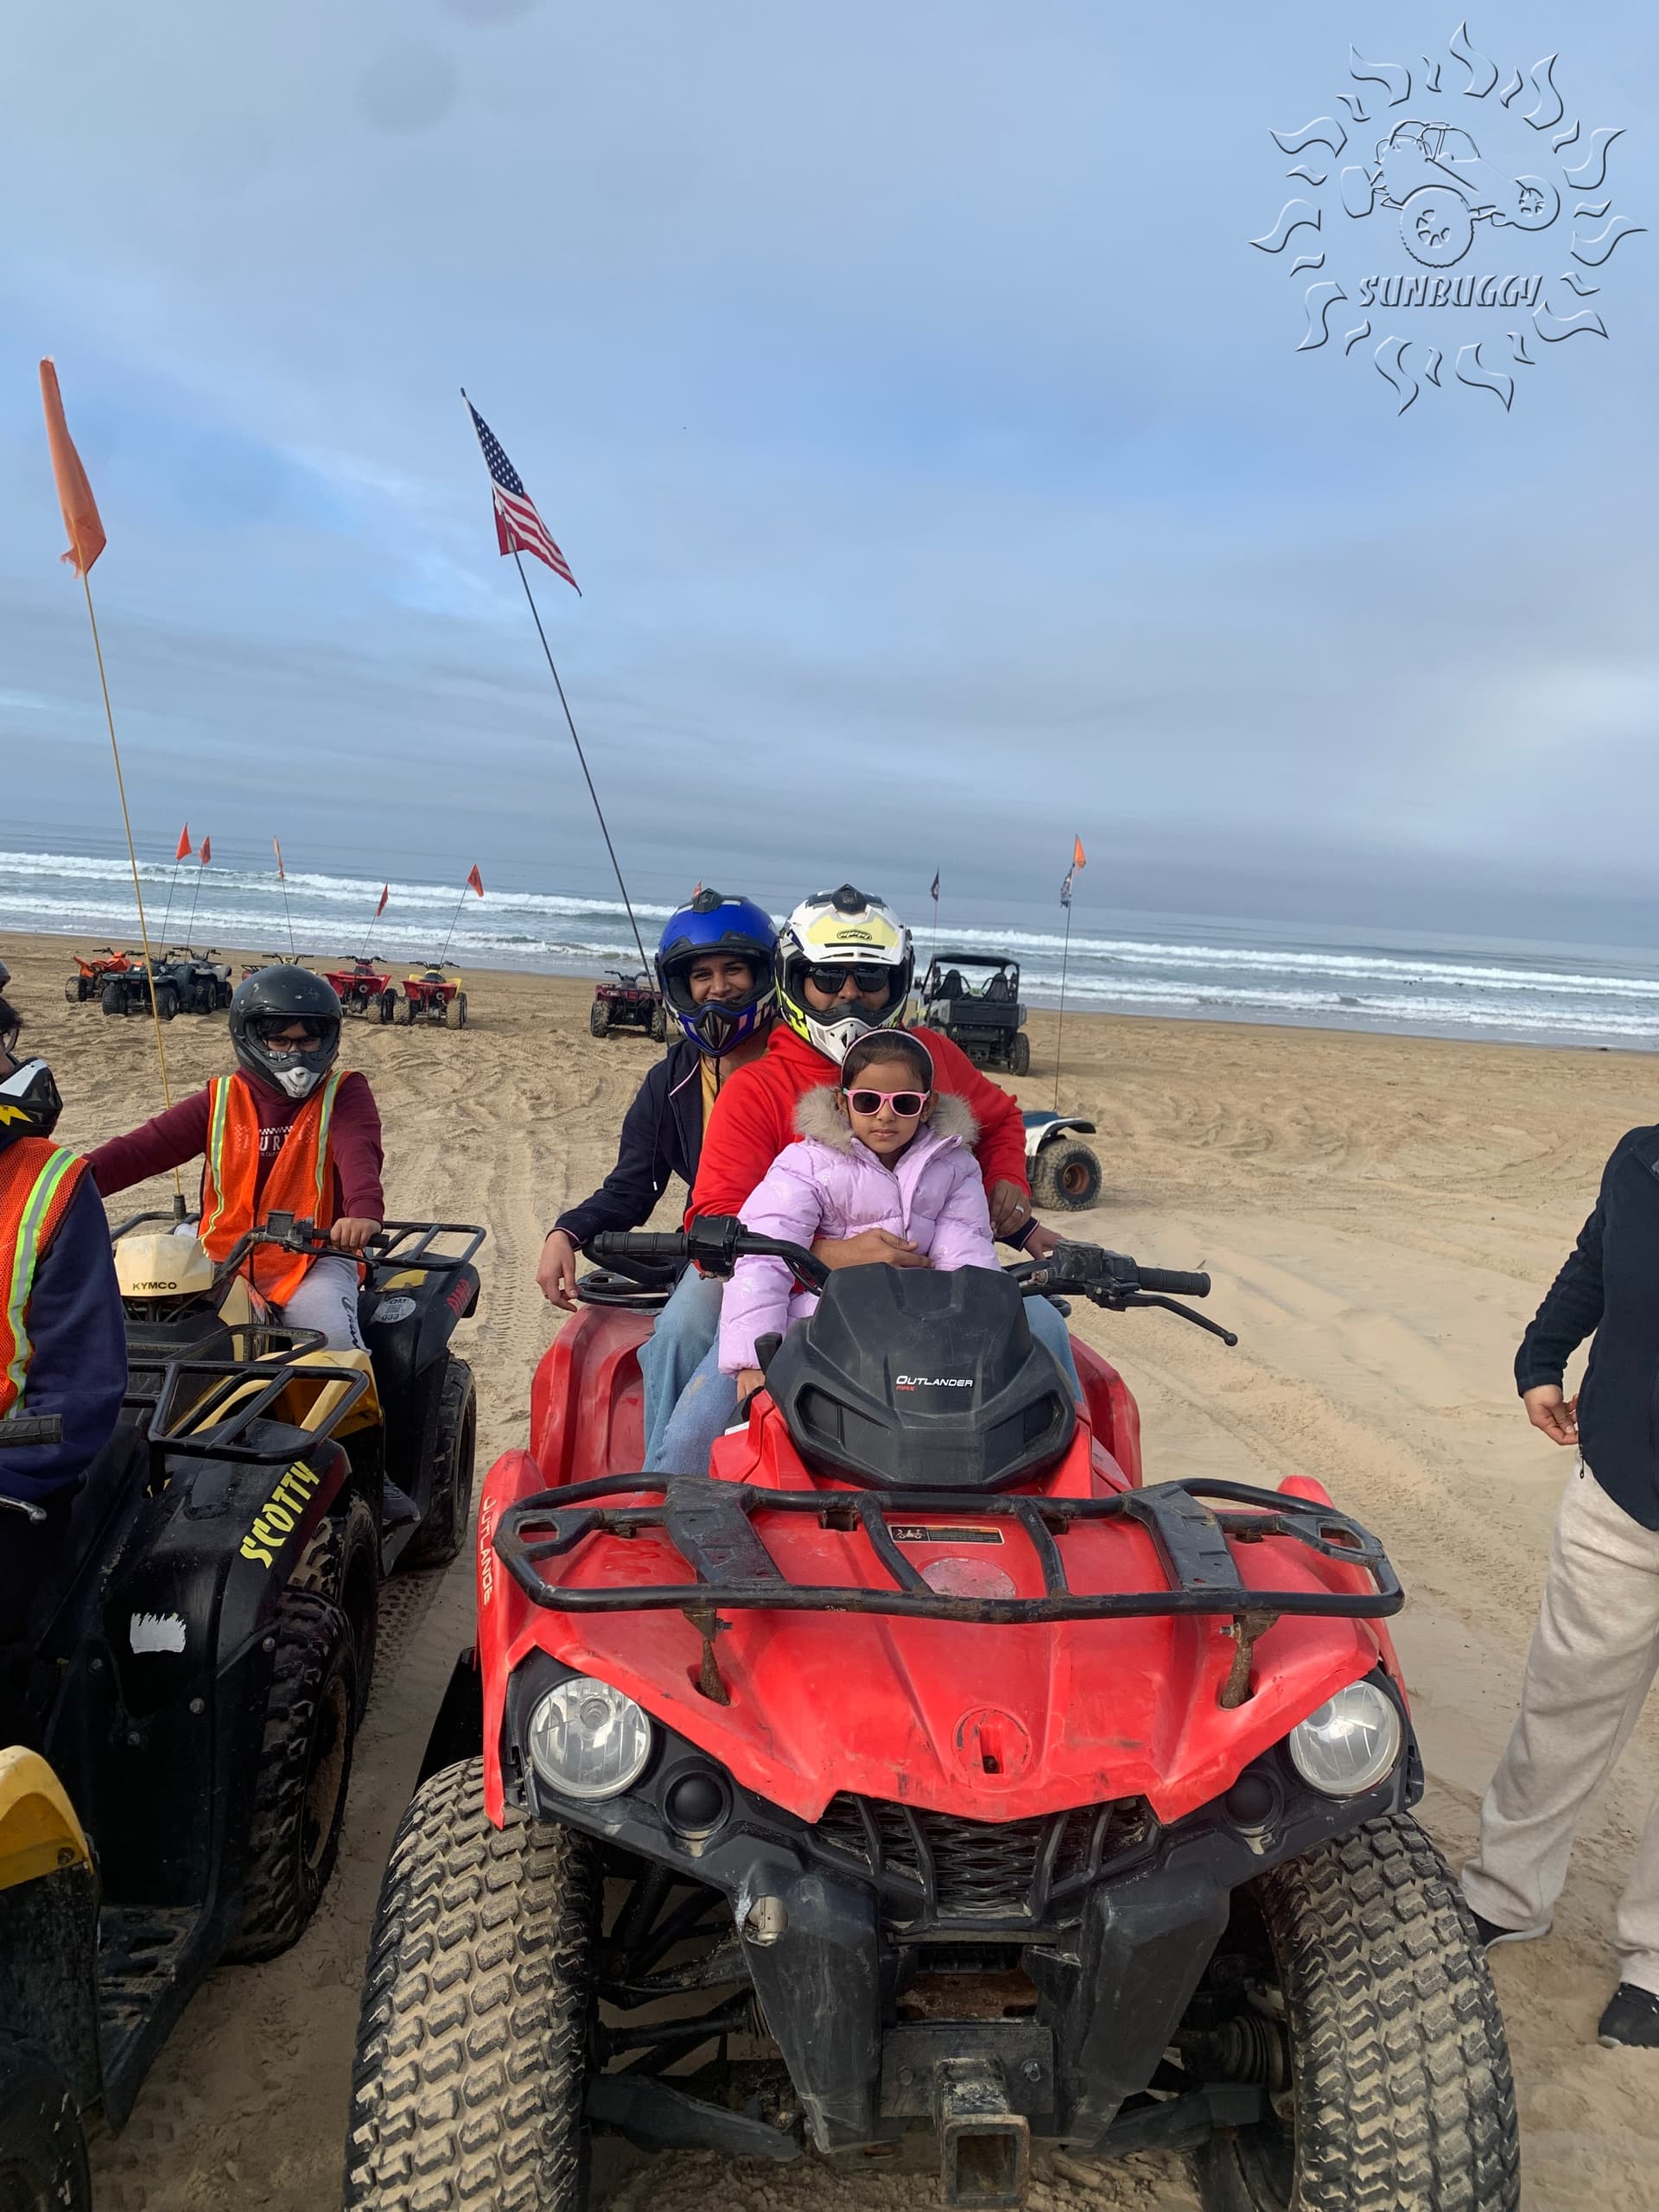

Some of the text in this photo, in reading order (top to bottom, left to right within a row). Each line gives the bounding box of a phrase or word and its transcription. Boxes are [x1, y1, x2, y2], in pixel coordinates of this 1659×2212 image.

[132, 1281, 177, 1291] KYMCO
[895, 1375, 974, 1388] OUTLANDER
[239, 1460, 320, 1569] SCOTTY
